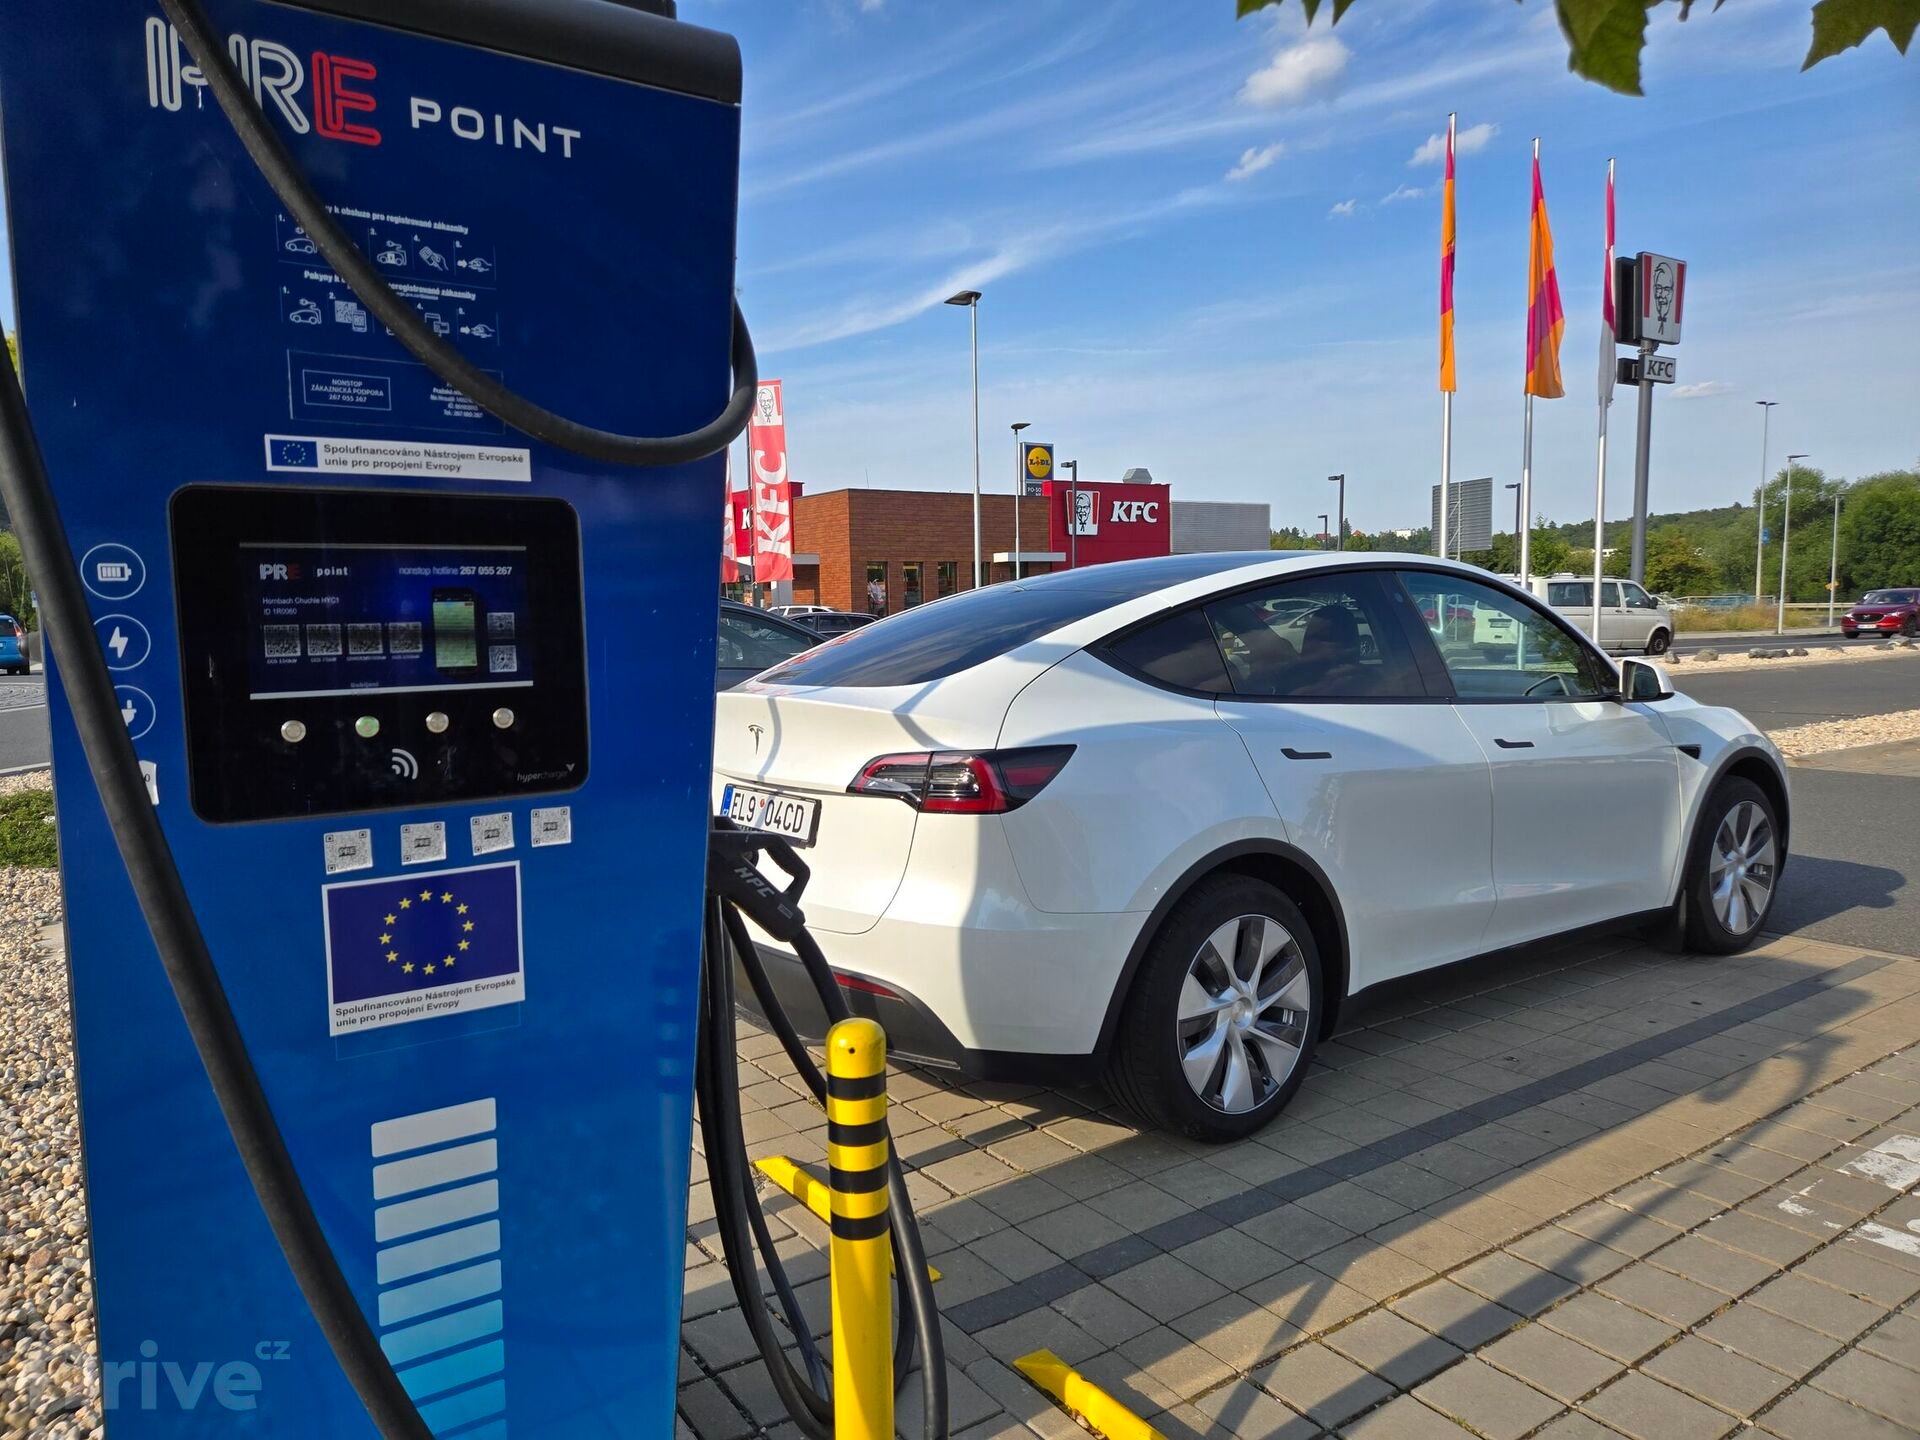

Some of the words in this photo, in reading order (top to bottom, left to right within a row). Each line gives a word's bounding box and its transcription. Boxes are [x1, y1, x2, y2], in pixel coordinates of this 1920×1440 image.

[411, 96, 581, 159] POINT
[1647, 360, 1673, 378] KFC
[332, 379, 363, 388] NONSTOP
[324, 444, 420, 457] Spolufinancováno
[423, 449, 475, 461] Nástrojem
[478, 452, 524, 463] Evropské
[325, 458, 348, 467] unie
[352, 460, 370, 469] pro
[425, 461, 462, 472] Evropy
[754, 450, 791, 559] KFC
[1110, 501, 1159, 523] KFC
[316, 566, 348, 578] point
[460, 566, 476, 576] 267
[496, 566, 512, 576] 267
[731, 792, 756, 823] EL9
[734, 866, 775, 898] HPC
[335, 995, 423, 1017] Spolufinancováno
[425, 985, 473, 1001] Nástrojem
[475, 977, 516, 993] Evropské
[336, 1016, 358, 1028] unie
[360, 1013, 376, 1025] pro
[427, 1000, 460, 1012] Evropy
